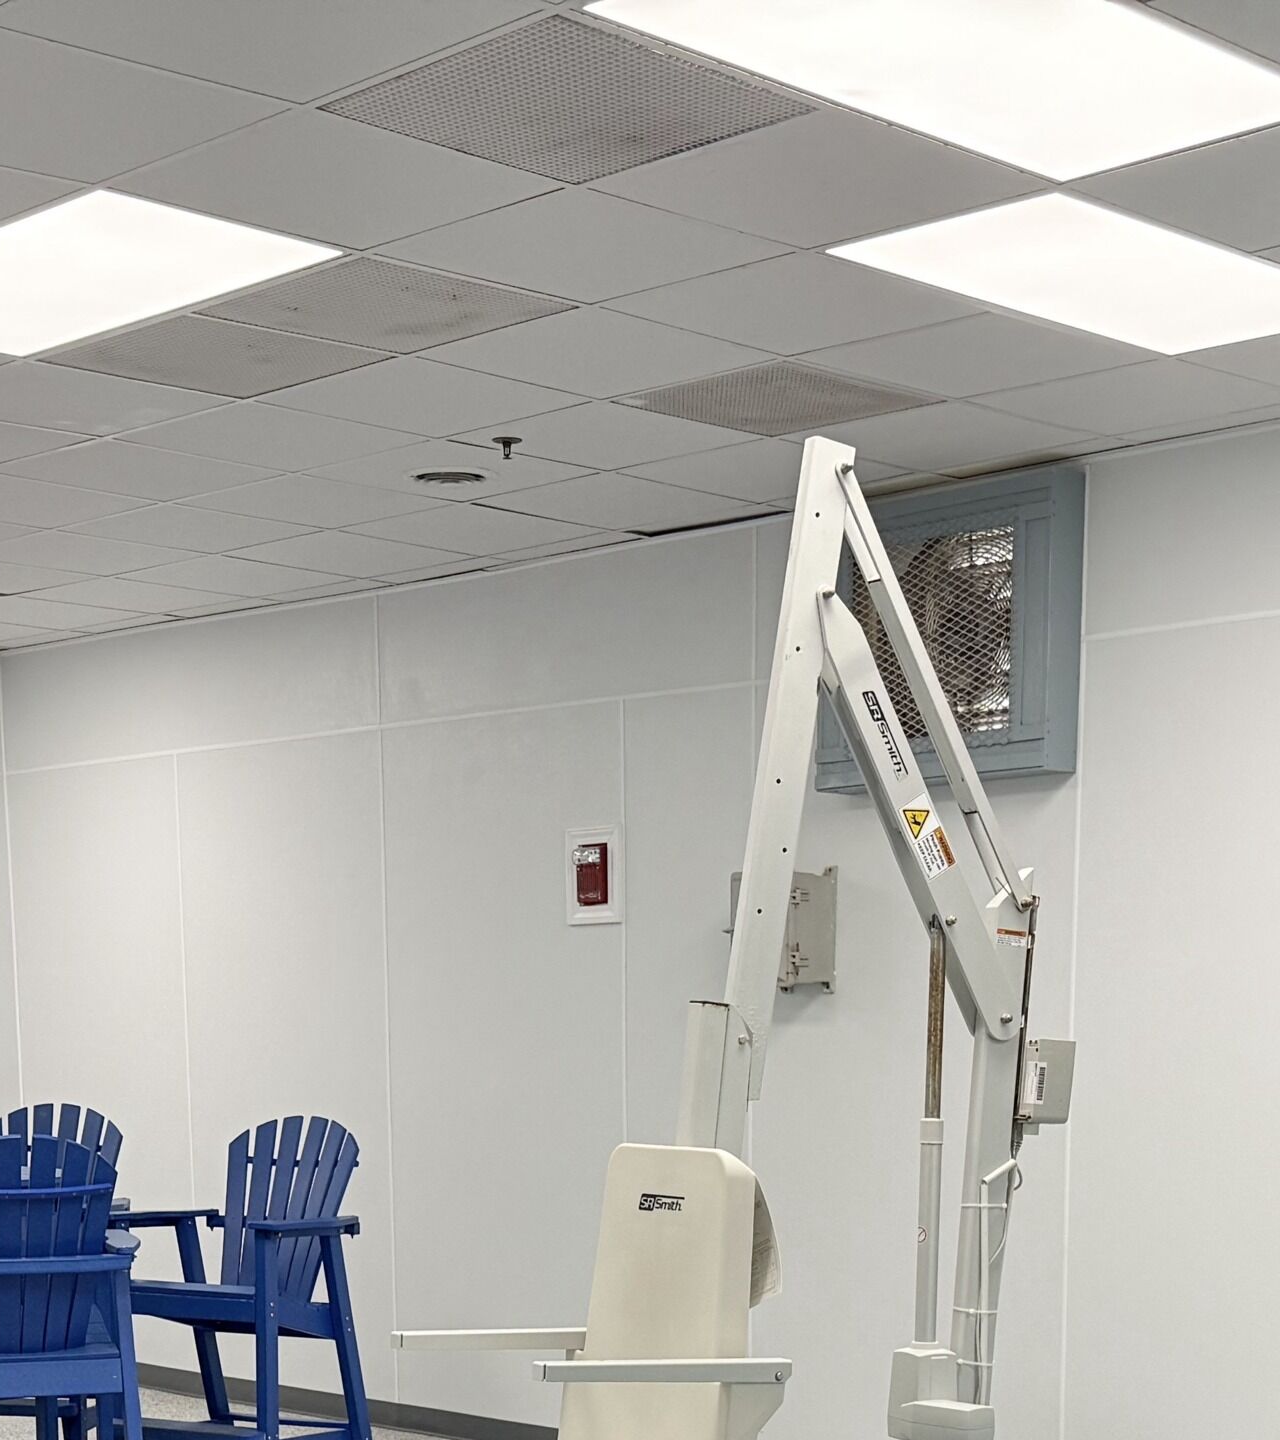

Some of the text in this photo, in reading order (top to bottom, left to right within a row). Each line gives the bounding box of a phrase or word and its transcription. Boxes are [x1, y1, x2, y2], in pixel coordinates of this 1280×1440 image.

[862, 691, 883, 722] SR
[877, 721, 904, 775] Smith
[639, 1195, 655, 1211] SR
